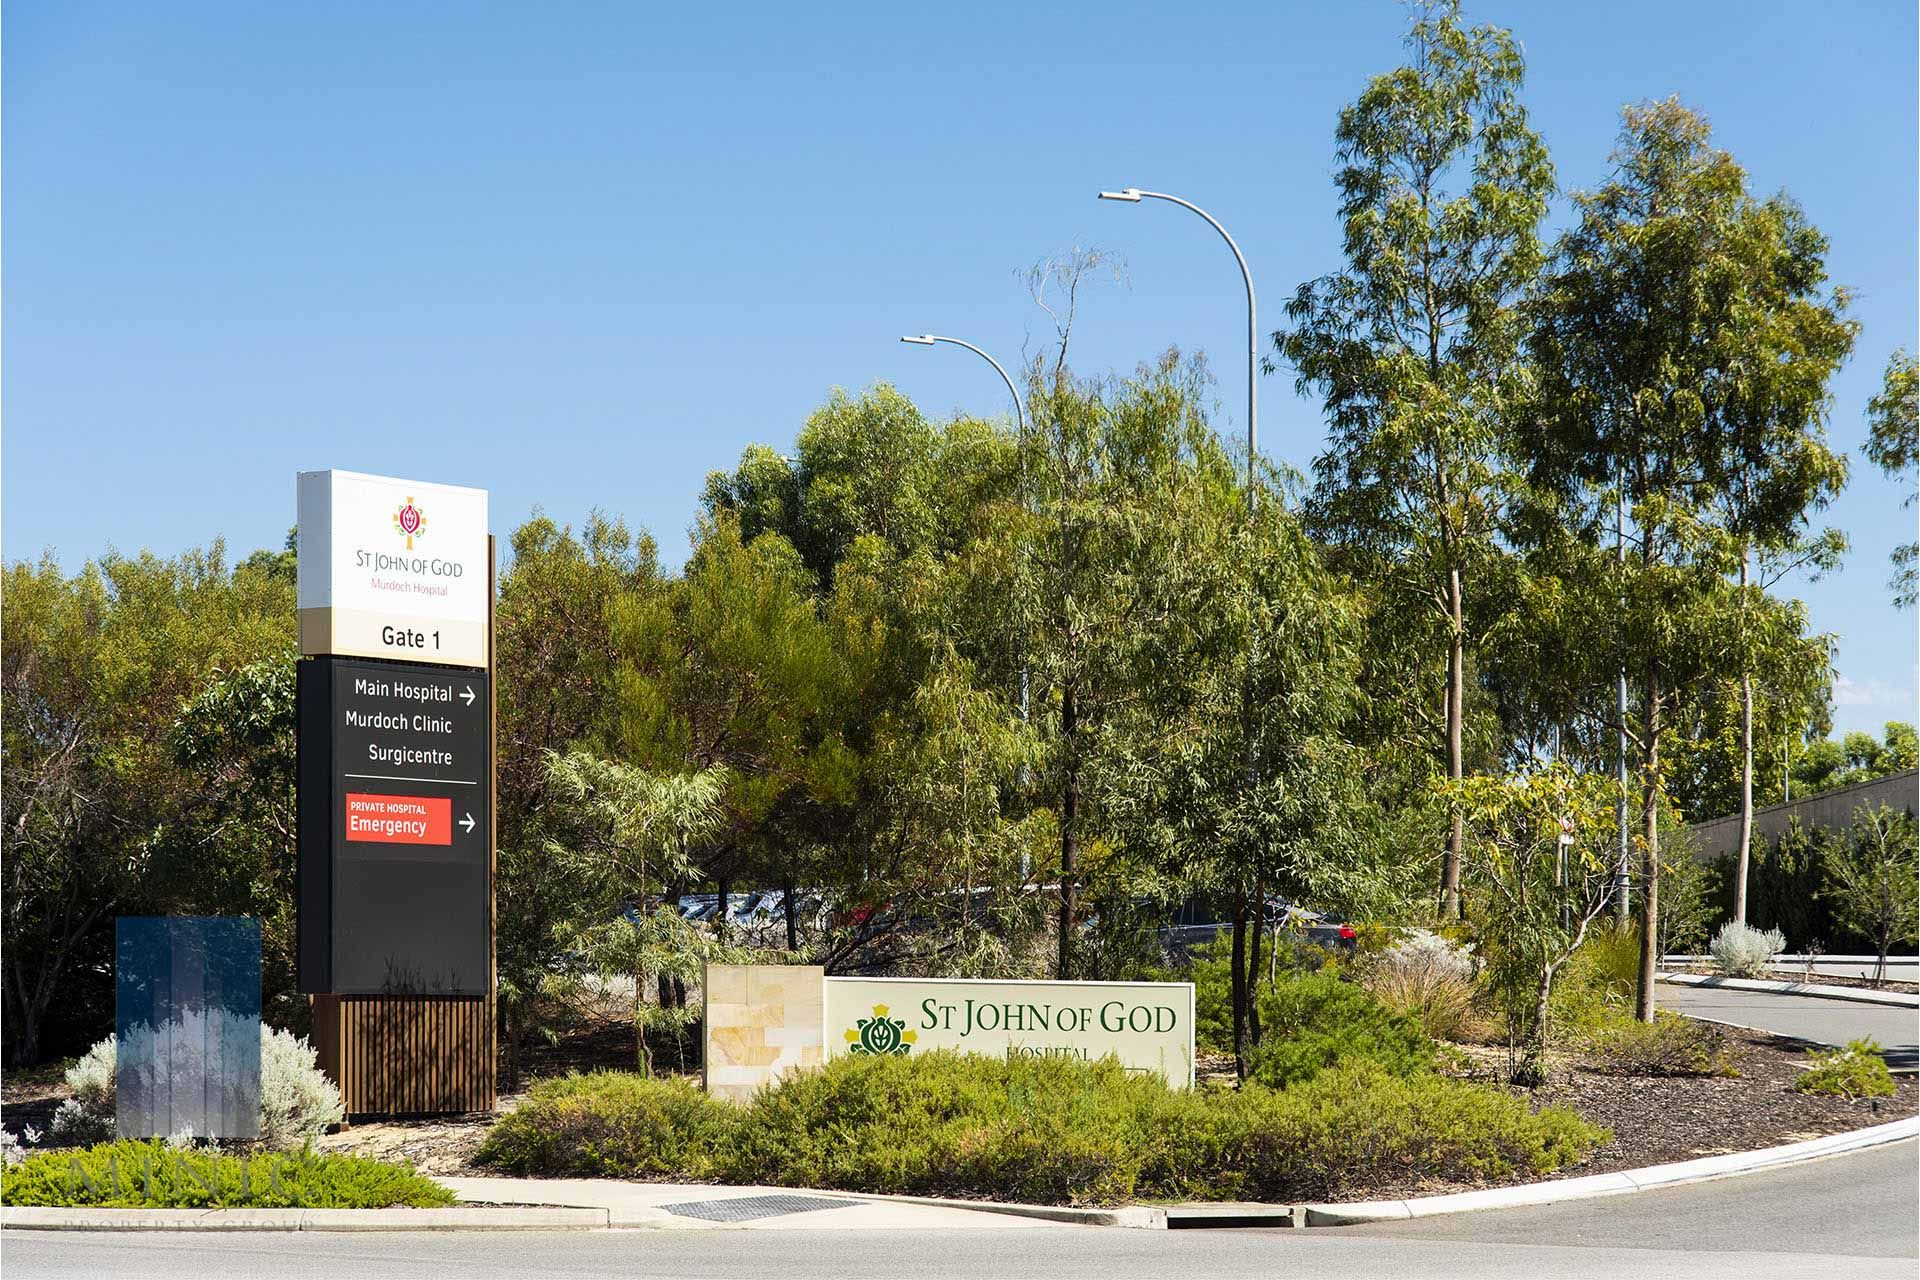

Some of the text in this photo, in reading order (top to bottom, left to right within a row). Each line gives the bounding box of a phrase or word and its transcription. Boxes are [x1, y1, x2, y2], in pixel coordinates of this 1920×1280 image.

[356, 549, 463, 577] ST JOHN OF GOD
[370, 578, 448, 597] Murdoch Hospital
[382, 626, 440, 649] Gate 1
[355, 678, 452, 703] Main Hospital
[345, 710, 453, 733] Murdoch Clinic
[369, 744, 453, 766] Surgicentre
[351, 801, 427, 815] PRIVATE HOSPITAL
[350, 815, 427, 838] Emergency
[920, 998, 1177, 1037] ST JOHN OF GOD
